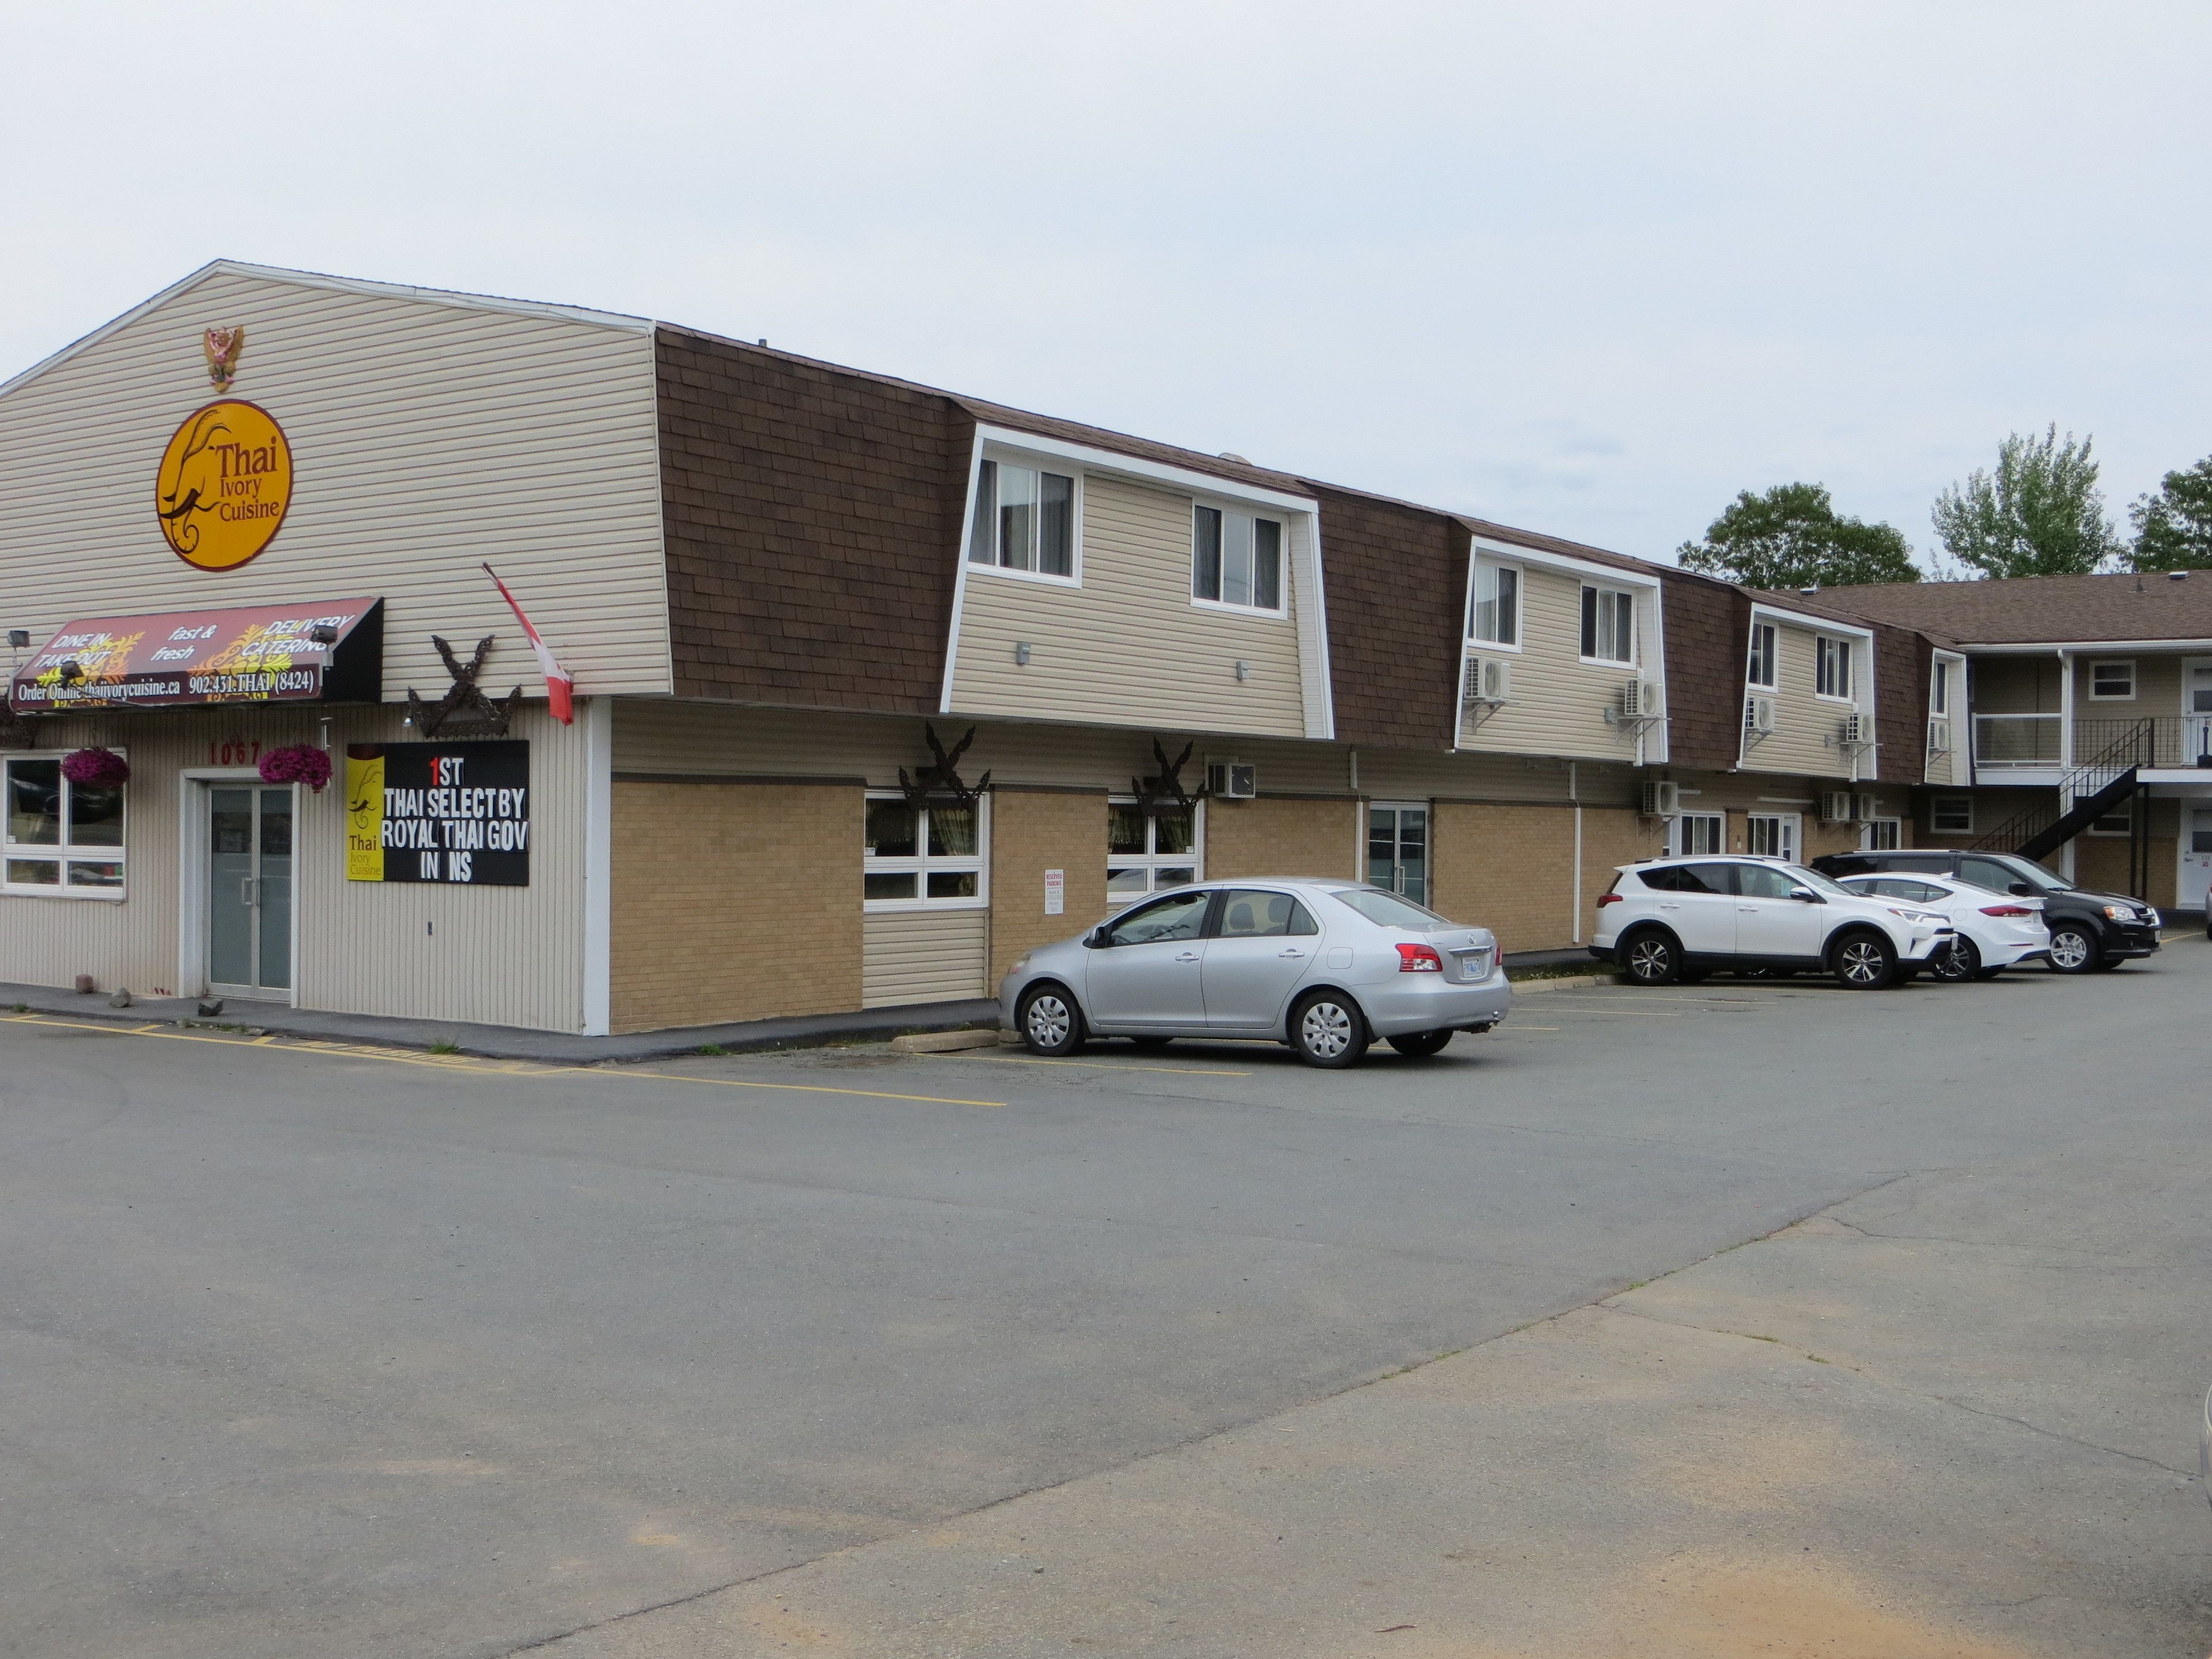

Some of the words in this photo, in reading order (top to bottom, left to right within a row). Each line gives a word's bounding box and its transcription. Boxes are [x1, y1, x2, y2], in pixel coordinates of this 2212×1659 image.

[215, 436, 277, 478] Thai
[221, 478, 262, 499] Ivory
[219, 499, 280, 522] Cuisine
[167, 626, 203, 641] fast
[200, 624, 218, 638] &
[263, 615, 356, 635] DELIVERY
[52, 634, 90, 649] DINE
[86, 632, 112, 646] IN
[241, 638, 327, 657] CATERING
[34, 653, 75, 668] TAKE
[73, 651, 112, 664] OUT
[150, 645, 195, 661] fresh
[18, 684, 47, 701] Order
[189, 672, 271, 694] 902.431.THAI
[274, 670, 314, 695] (8424)
[211, 741, 259, 765] 1067
[429, 756, 464, 786] 1ST
[384, 788, 423, 817] THAI
[427, 788, 497, 818] SELECT
[499, 788, 525, 819] BY
[349, 835, 377, 851] Thai
[381, 819, 438, 849] ROYAL
[442, 820, 483, 849] THAI
[488, 820, 528, 851] GOV
[350, 852, 371, 864] Ivory
[421, 851, 438, 880] IN
[449, 851, 472, 882] NS
[350, 864, 381, 876] Cuisine
